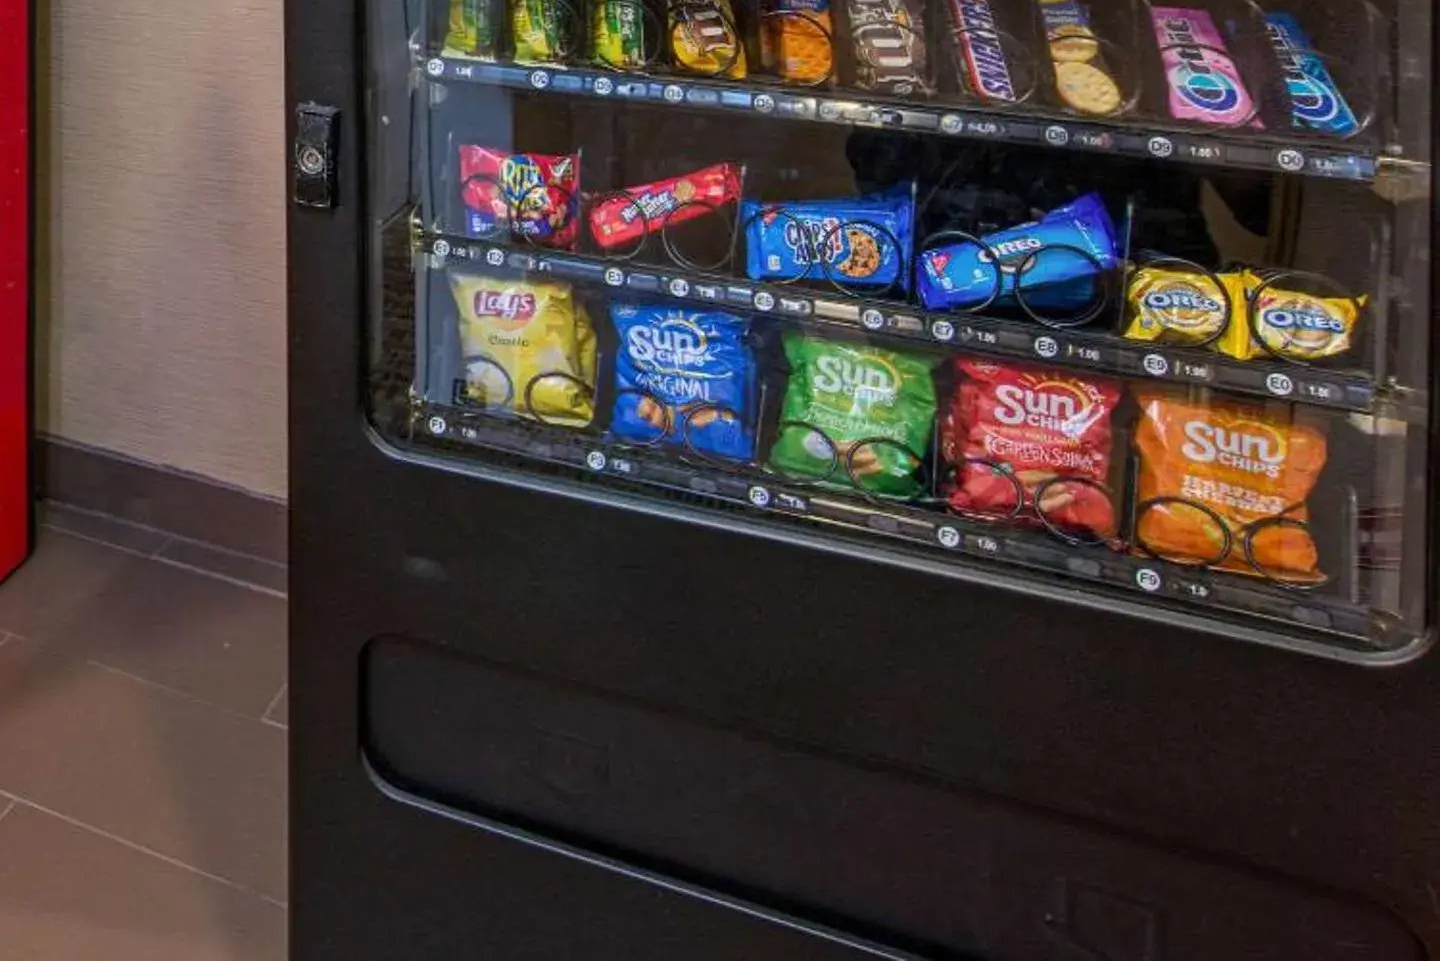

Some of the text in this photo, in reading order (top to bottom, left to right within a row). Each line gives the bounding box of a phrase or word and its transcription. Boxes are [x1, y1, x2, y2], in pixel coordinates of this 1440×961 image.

[1146, 292, 1220, 312] OREO
[1265, 310, 1345, 332] OREO
[628, 325, 706, 360] Sun
[814, 357, 896, 393] Sun
[994, 384, 1090, 425] Sun
[1182, 421, 1287, 464] Sun
[1217, 450, 1282, 478] CHIPS
